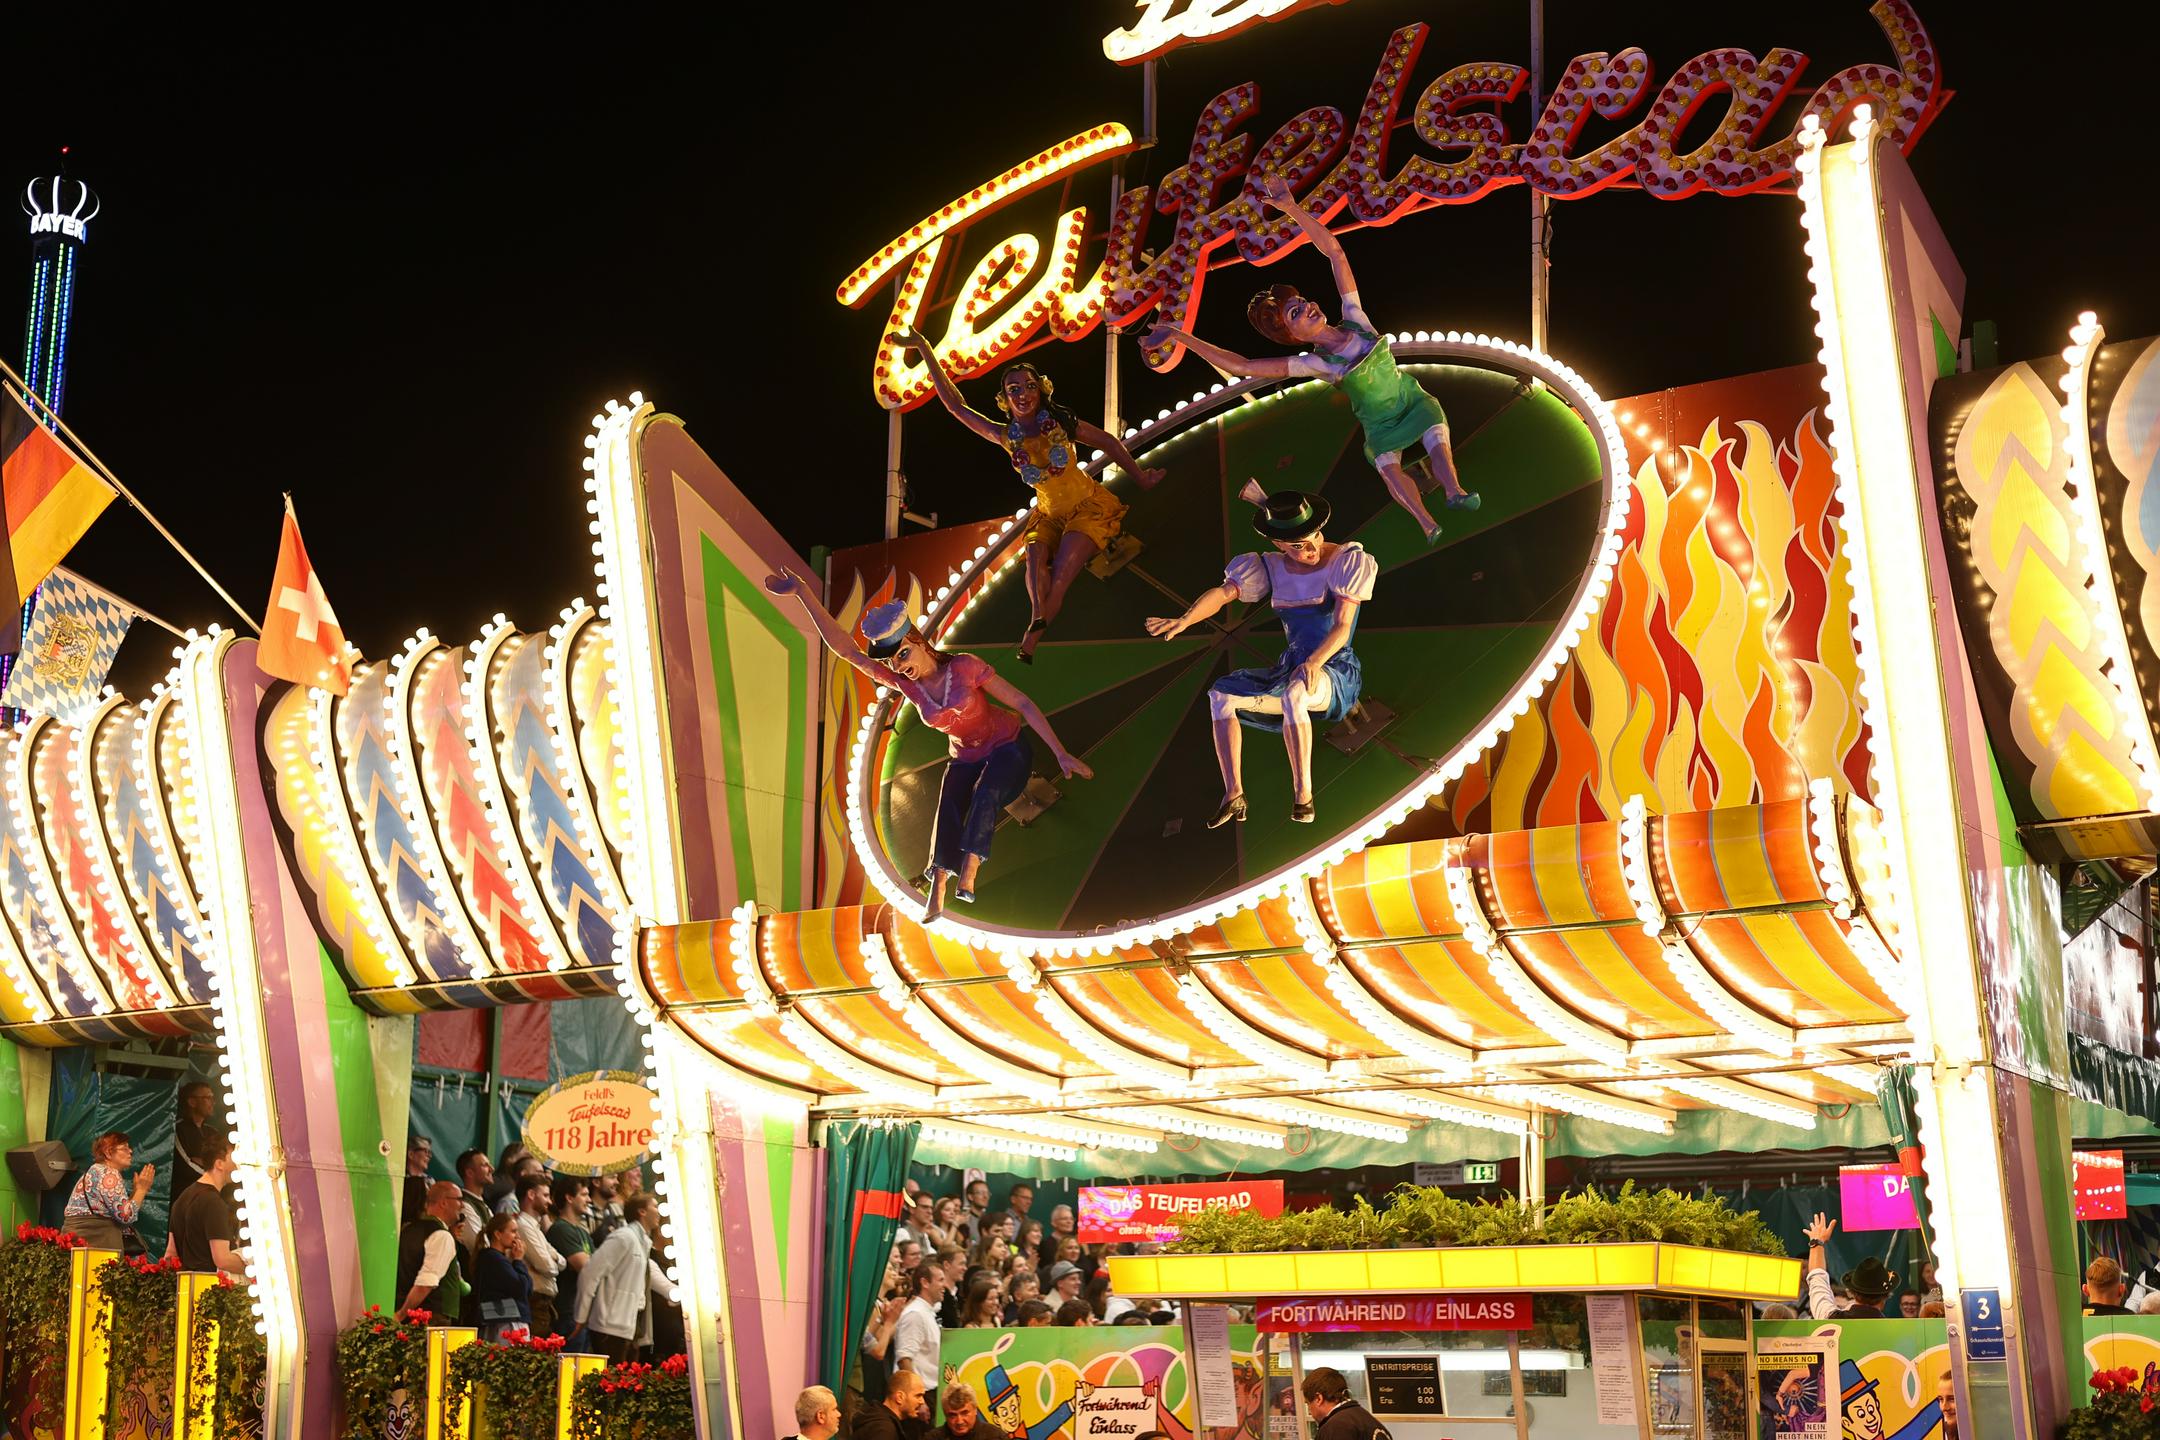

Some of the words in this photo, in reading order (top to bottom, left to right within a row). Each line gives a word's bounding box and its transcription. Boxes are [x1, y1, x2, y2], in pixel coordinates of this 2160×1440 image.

[836, 0, 1943, 413] Teufelsrad
[30, 213, 87, 245] BAYER
[583, 1087, 615, 1101] Feldl's
[567, 1102, 631, 1123] Teufelsrad
[544, 1126, 581, 1151] 118
[586, 1121, 653, 1153] Jahre
[1882, 1175, 1910, 1198] DA
[1110, 1191, 1143, 1215] DAS
[1119, 1224, 1142, 1235] ohne
[1271, 1302, 1406, 1322] FORTWÄHREND
[1436, 1302, 1515, 1320] EINLASS
[1977, 1297, 1990, 1320] 3
[1370, 1363, 1435, 1371] EINTRITTSPREISE
[1078, 1397, 1151, 1415] Fortwährend
[1089, 1416, 1137, 1434] Einlass
